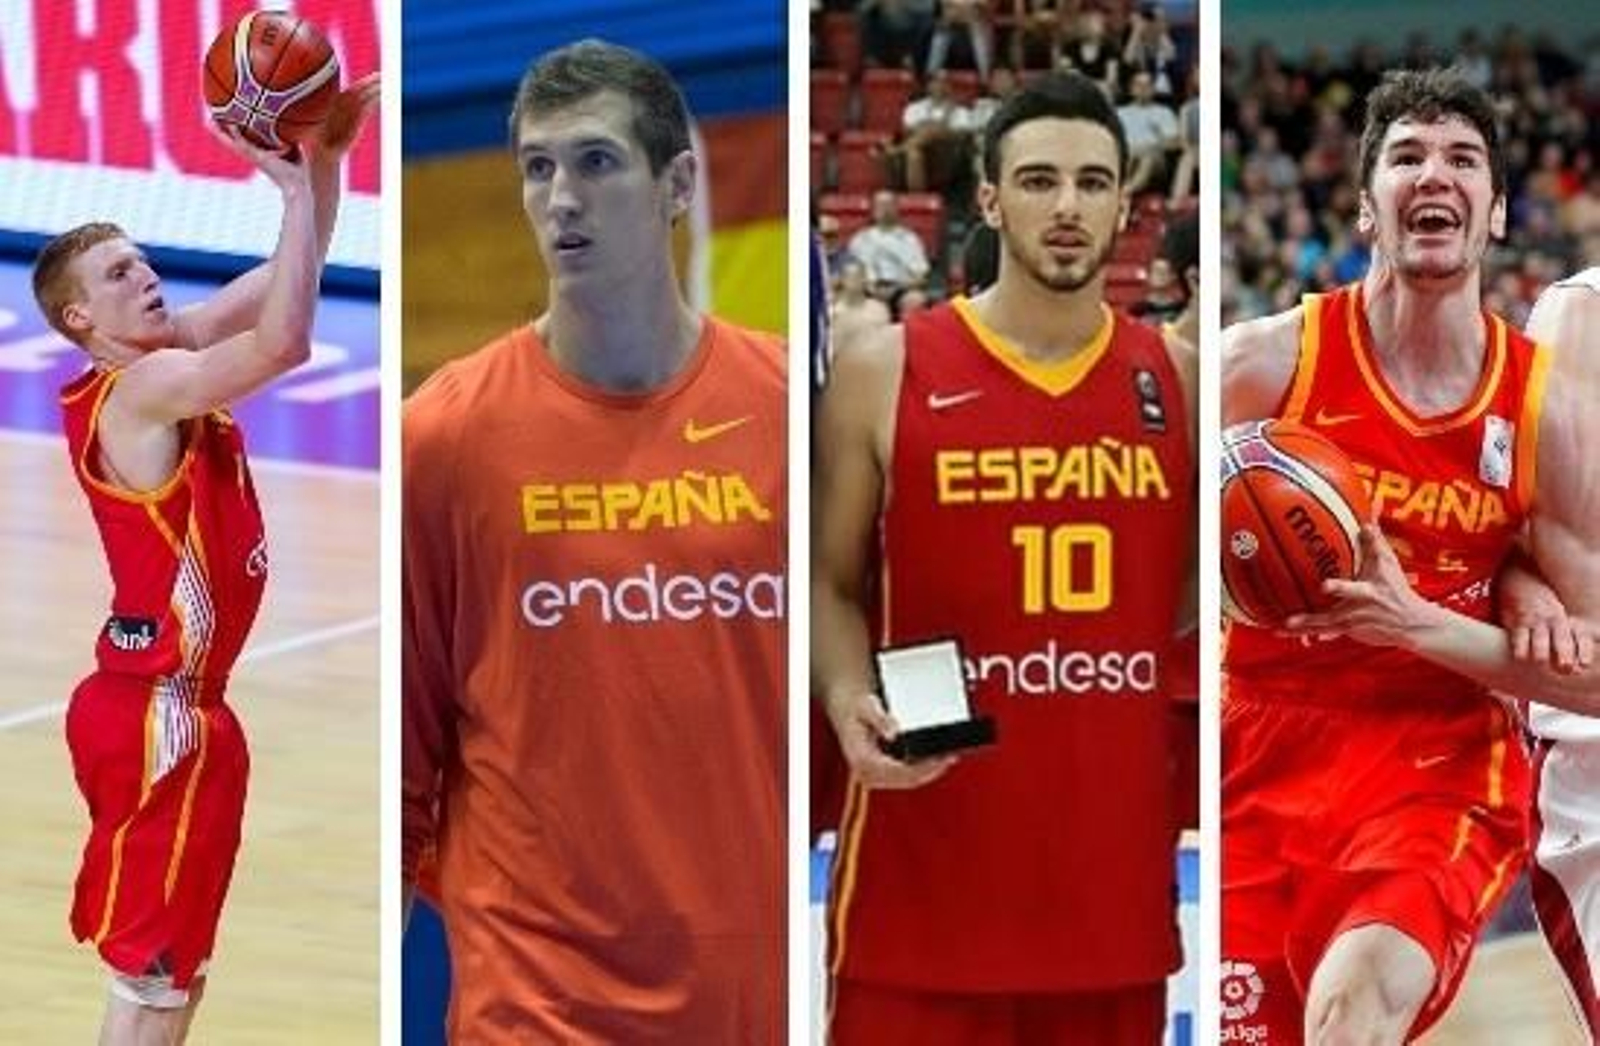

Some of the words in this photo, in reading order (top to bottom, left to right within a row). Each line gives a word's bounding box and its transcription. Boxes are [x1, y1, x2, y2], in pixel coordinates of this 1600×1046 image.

[521, 469, 771, 534] ESPAÑA
[937, 436, 1169, 505] ESPAÑA
[1350, 461, 1507, 533] SPAÑA
[521, 563, 785, 627] endesa
[1012, 523, 1112, 614] 10
